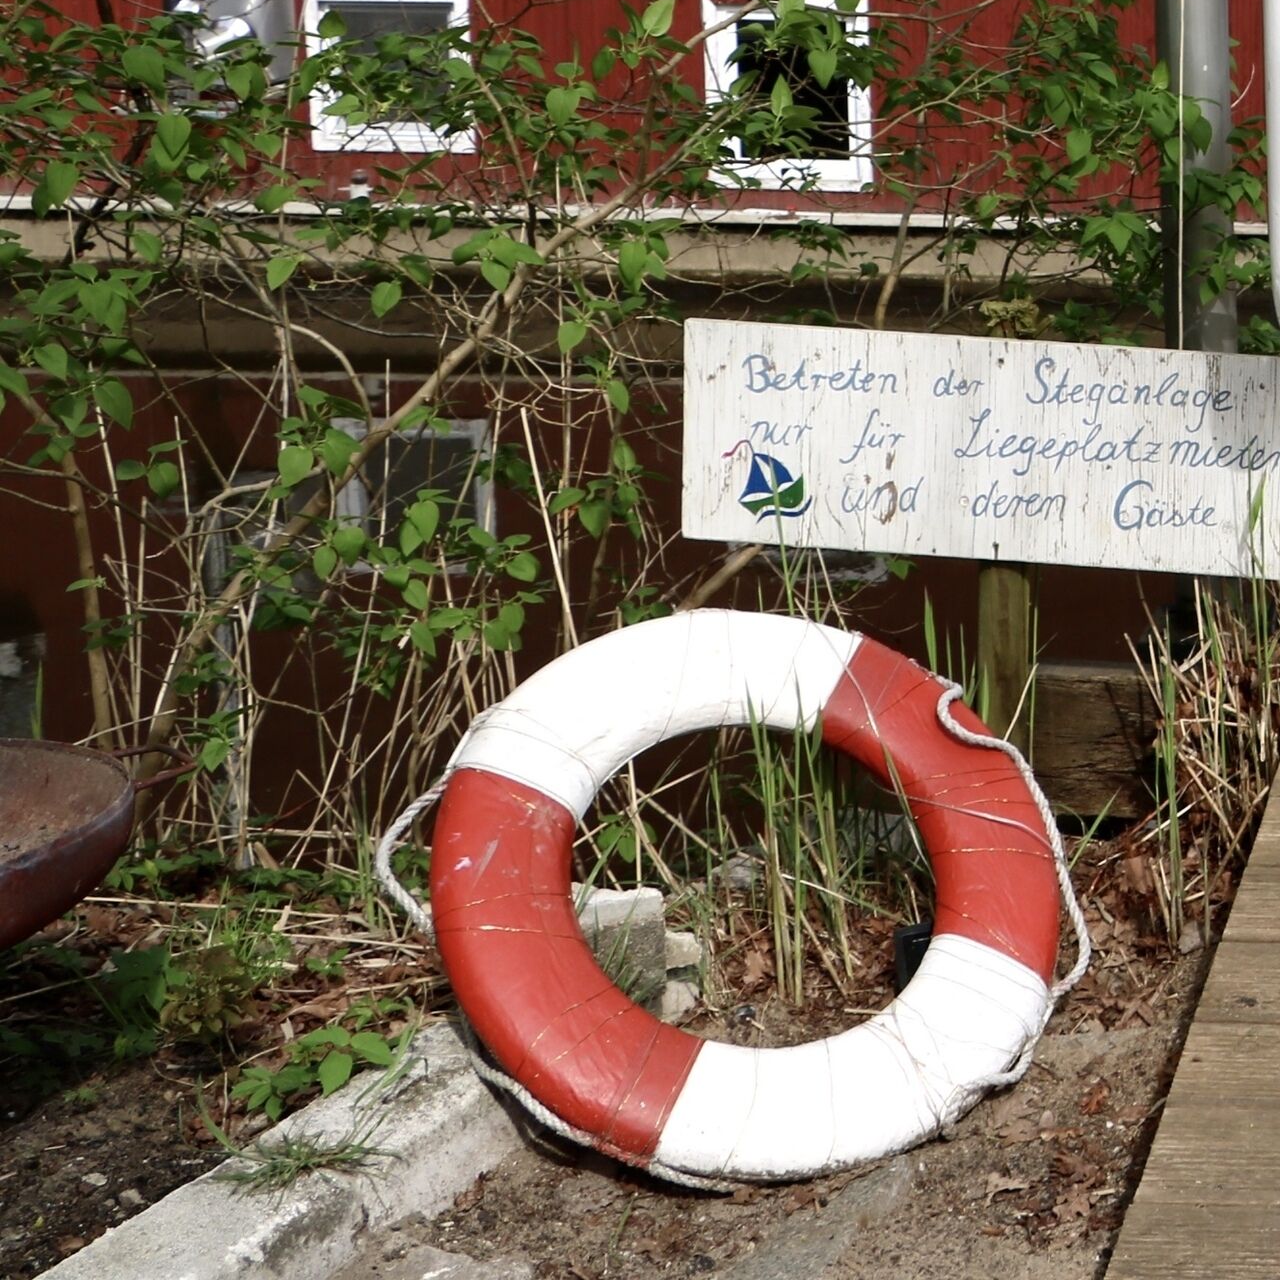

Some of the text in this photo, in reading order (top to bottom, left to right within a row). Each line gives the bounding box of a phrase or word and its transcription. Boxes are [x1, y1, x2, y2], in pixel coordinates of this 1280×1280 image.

[741, 352, 1235, 432] Betreten der Steganlage
[748, 419, 814, 447] nur
[838, 408, 907, 464] für
[840, 476, 1219, 532] und deren Gäste
